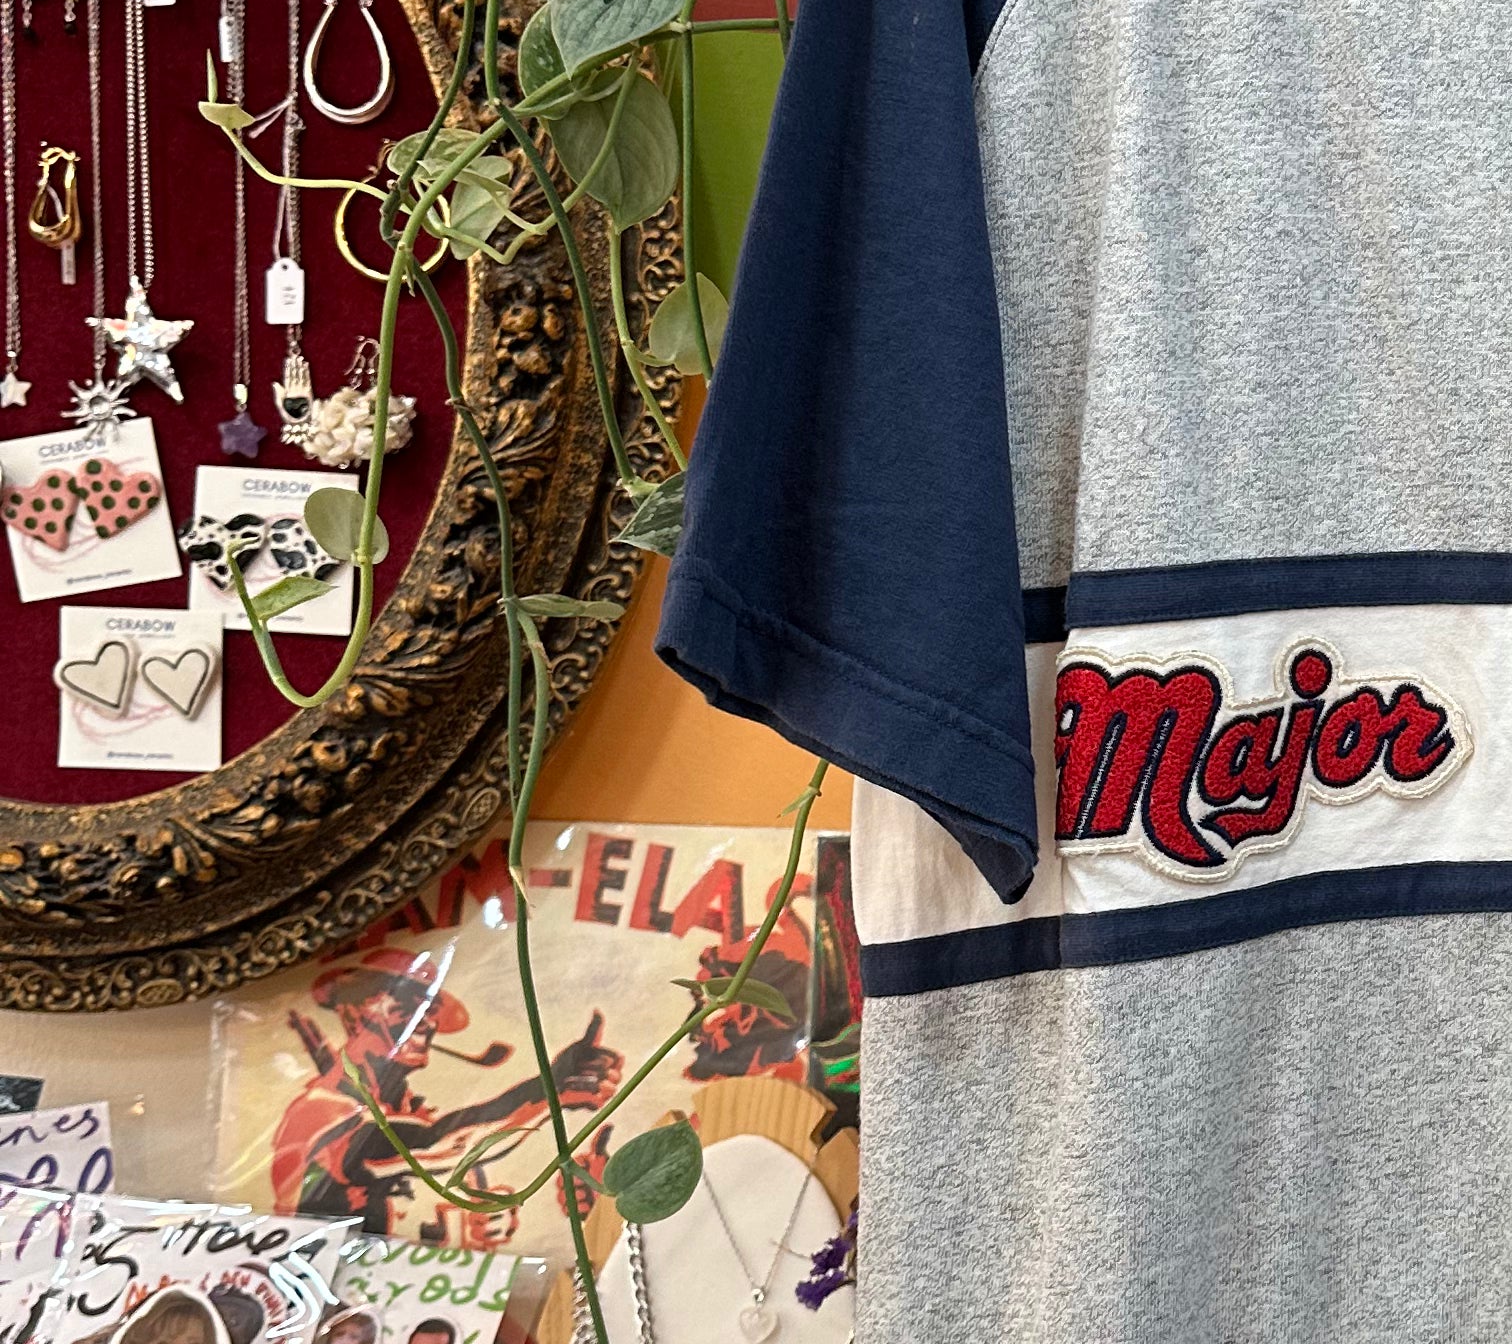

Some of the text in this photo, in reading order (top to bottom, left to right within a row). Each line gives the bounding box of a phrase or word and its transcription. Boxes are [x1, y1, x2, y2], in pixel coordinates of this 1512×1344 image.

[38, 437, 107, 458] CERABOW
[242, 478, 313, 494] CERABOW
[105, 617, 176, 633] CERABOW
[1056, 647, 1455, 868] Major
